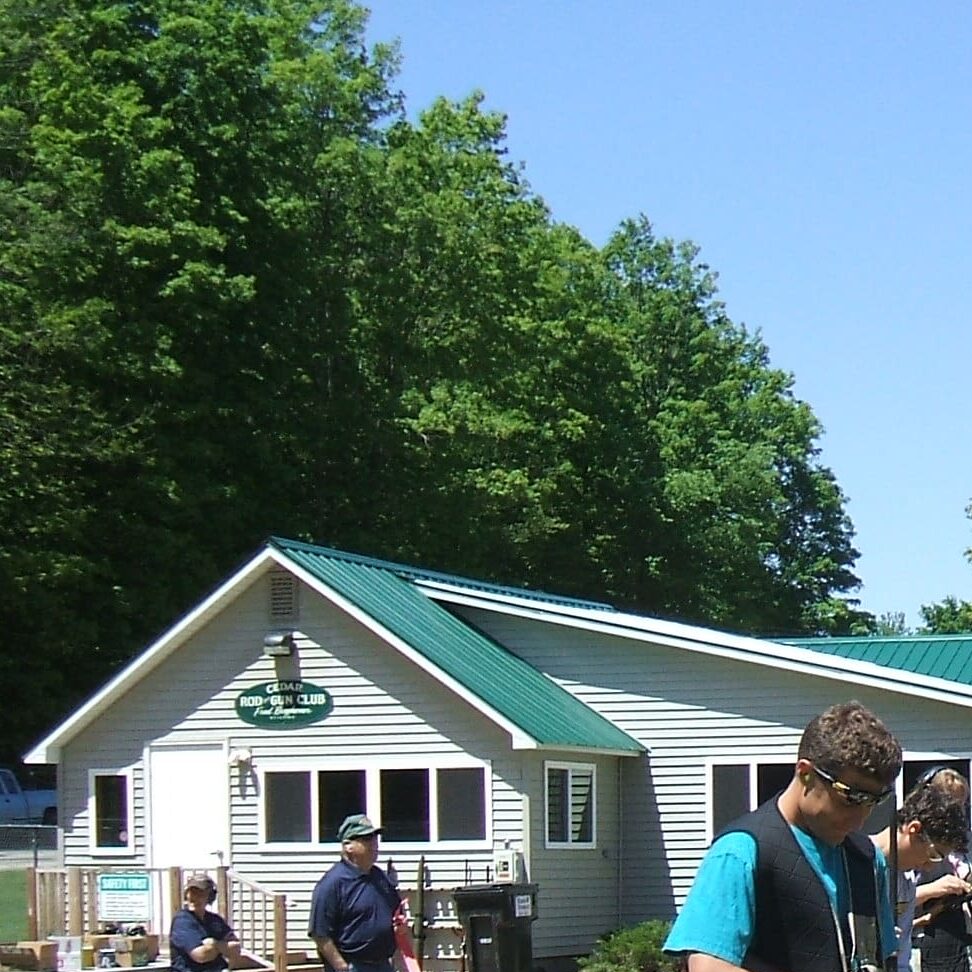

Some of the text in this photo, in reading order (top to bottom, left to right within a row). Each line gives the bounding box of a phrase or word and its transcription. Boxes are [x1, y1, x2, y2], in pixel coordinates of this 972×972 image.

[267, 683, 303, 694] CEDAR
[240, 695, 263, 707] ROD
[270, 695, 293, 706] GUN
[298, 694, 326, 705] CLUB
[102, 878, 147, 889] SAFETY FIRST
